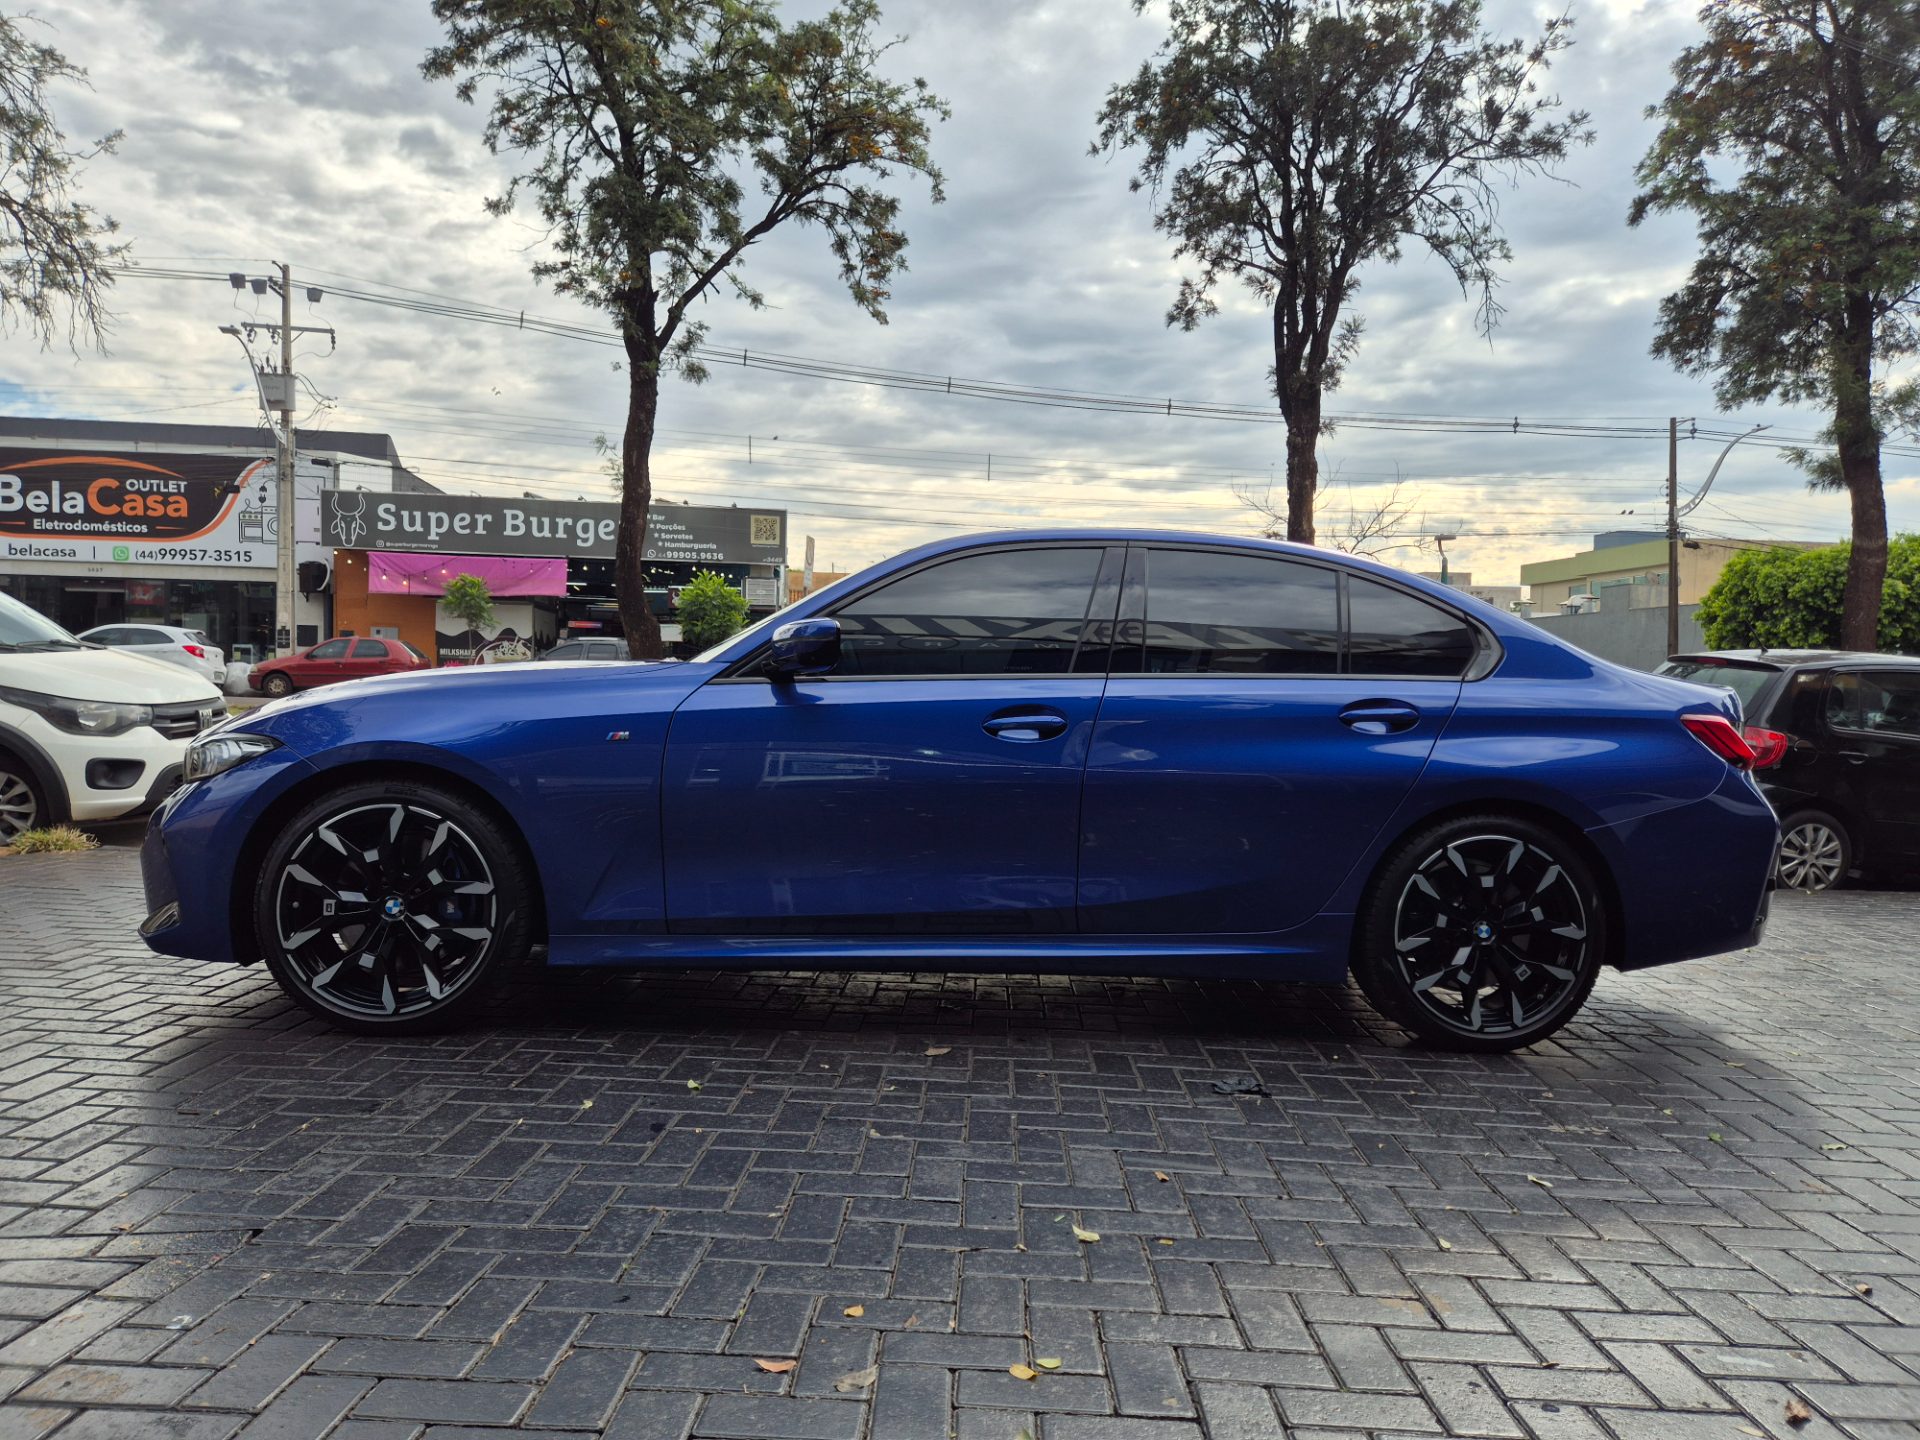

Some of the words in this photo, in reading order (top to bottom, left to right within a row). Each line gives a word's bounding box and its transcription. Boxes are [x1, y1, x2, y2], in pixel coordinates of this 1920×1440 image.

[126, 479, 188, 493] OUTLET
[33, 518, 148, 533] Eletrodomésticos
[377, 503, 492, 541] Super
[503, 509, 616, 547] Burge
[656, 522, 686, 531] Porções
[661, 532, 693, 540] Sorvetes
[8, 543, 77, 558] belacasa
[664, 541, 717, 550] Hamburgueria
